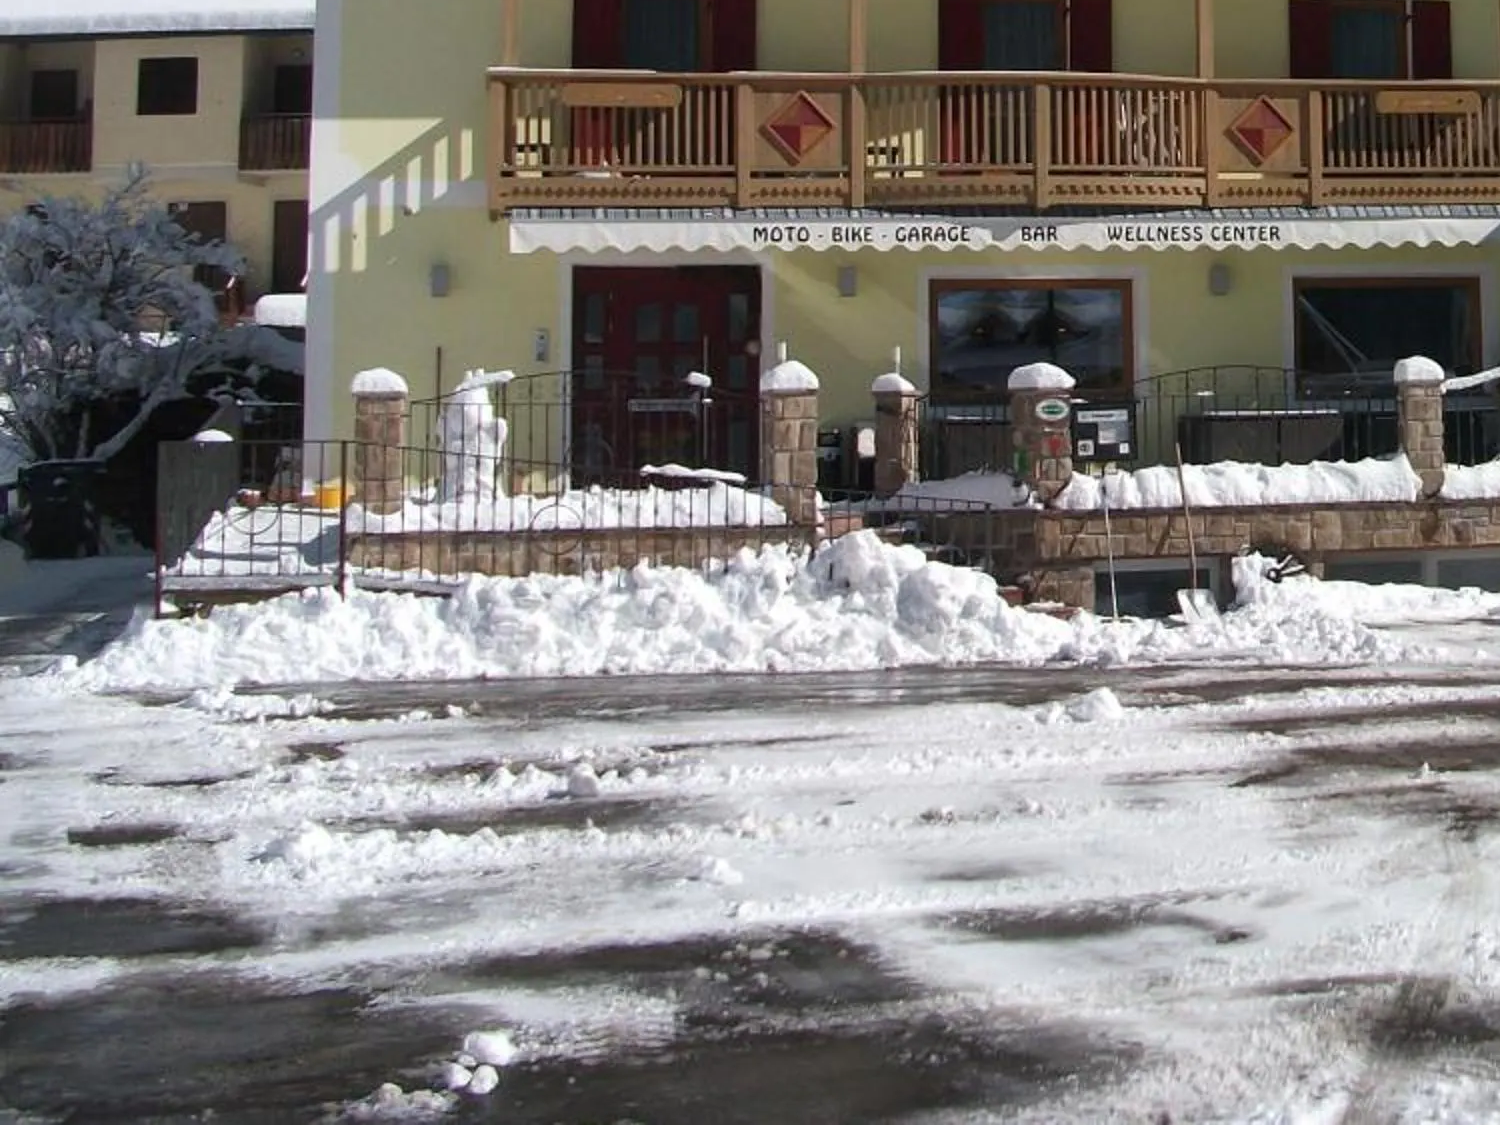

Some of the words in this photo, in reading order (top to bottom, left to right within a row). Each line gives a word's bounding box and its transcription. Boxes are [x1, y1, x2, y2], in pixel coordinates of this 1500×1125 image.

[753, 226, 811, 243] MOTO
[831, 226, 874, 243] BIKE
[895, 226, 972, 242] GARAGE
[1021, 226, 1058, 242] BAR
[1107, 226, 1203, 242] WELLNESS
[1210, 226, 1281, 242] CENTER
